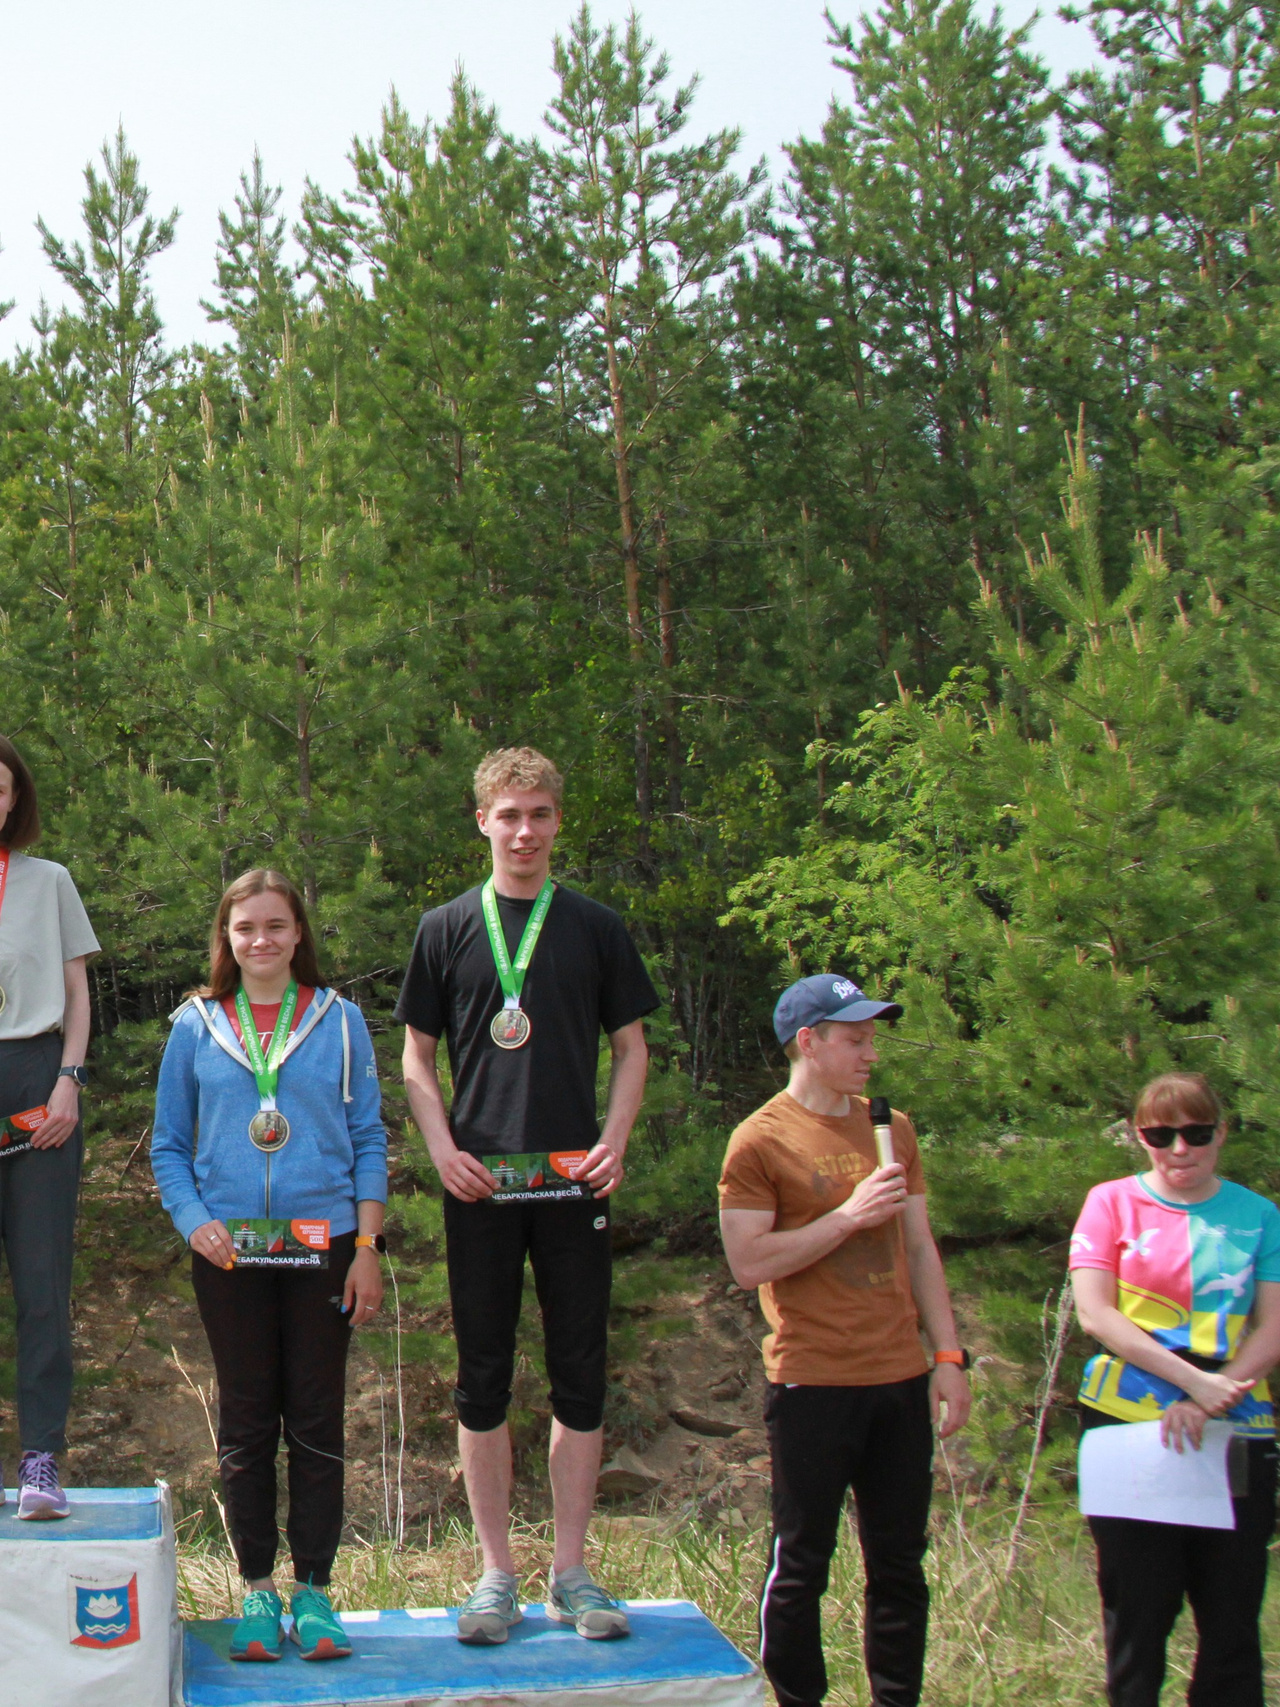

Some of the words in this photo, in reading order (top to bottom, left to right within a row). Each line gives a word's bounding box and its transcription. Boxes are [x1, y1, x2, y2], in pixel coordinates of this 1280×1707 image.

[491, 1191, 555, 1200] ЧЕБАРКУЛЬСКАЯ
[556, 1189, 582, 1197] ВЕСНА
[236, 1256, 293, 1264] ЕБАРКУЛЬСКАЯ
[295, 1257, 320, 1265] ВЕСНА
